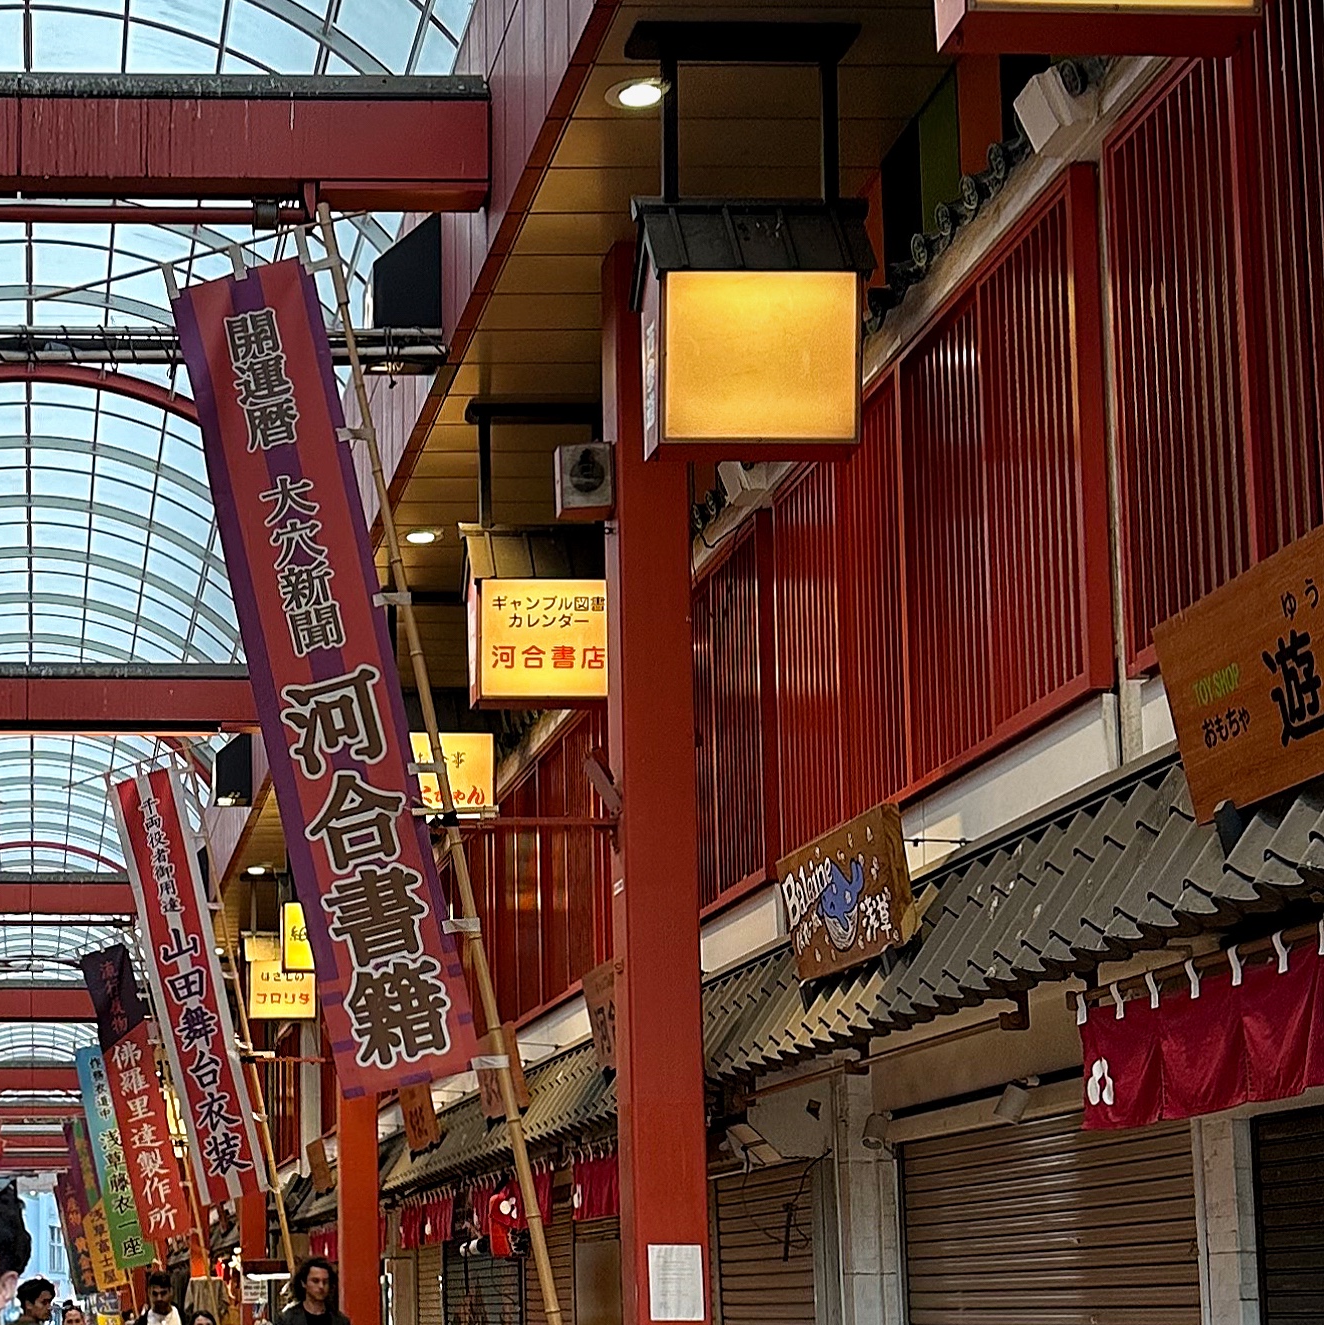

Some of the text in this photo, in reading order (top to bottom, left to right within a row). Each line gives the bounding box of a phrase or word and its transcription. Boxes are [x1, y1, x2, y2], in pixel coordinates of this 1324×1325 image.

[224, 307, 300, 454] 開運暦
[258, 475, 346, 658] 大穴新聞
[491, 595, 606, 613] ギャンブル図書
[1280, 577, 1320, 621] ゆう
[491, 644, 606, 670] 河合書店
[508, 613, 590, 629] カレンダー
[1192, 662, 1241, 706] TOY SHOP
[1261, 628, 1324, 748] 遊
[1201, 706, 1251, 749] おもちゃ
[281, 664, 451, 1072] 河合書籍
[158, 926, 255, 1179] 山田舞台衣装
[111, 1040, 178, 1234] 佛羅里達製作所
